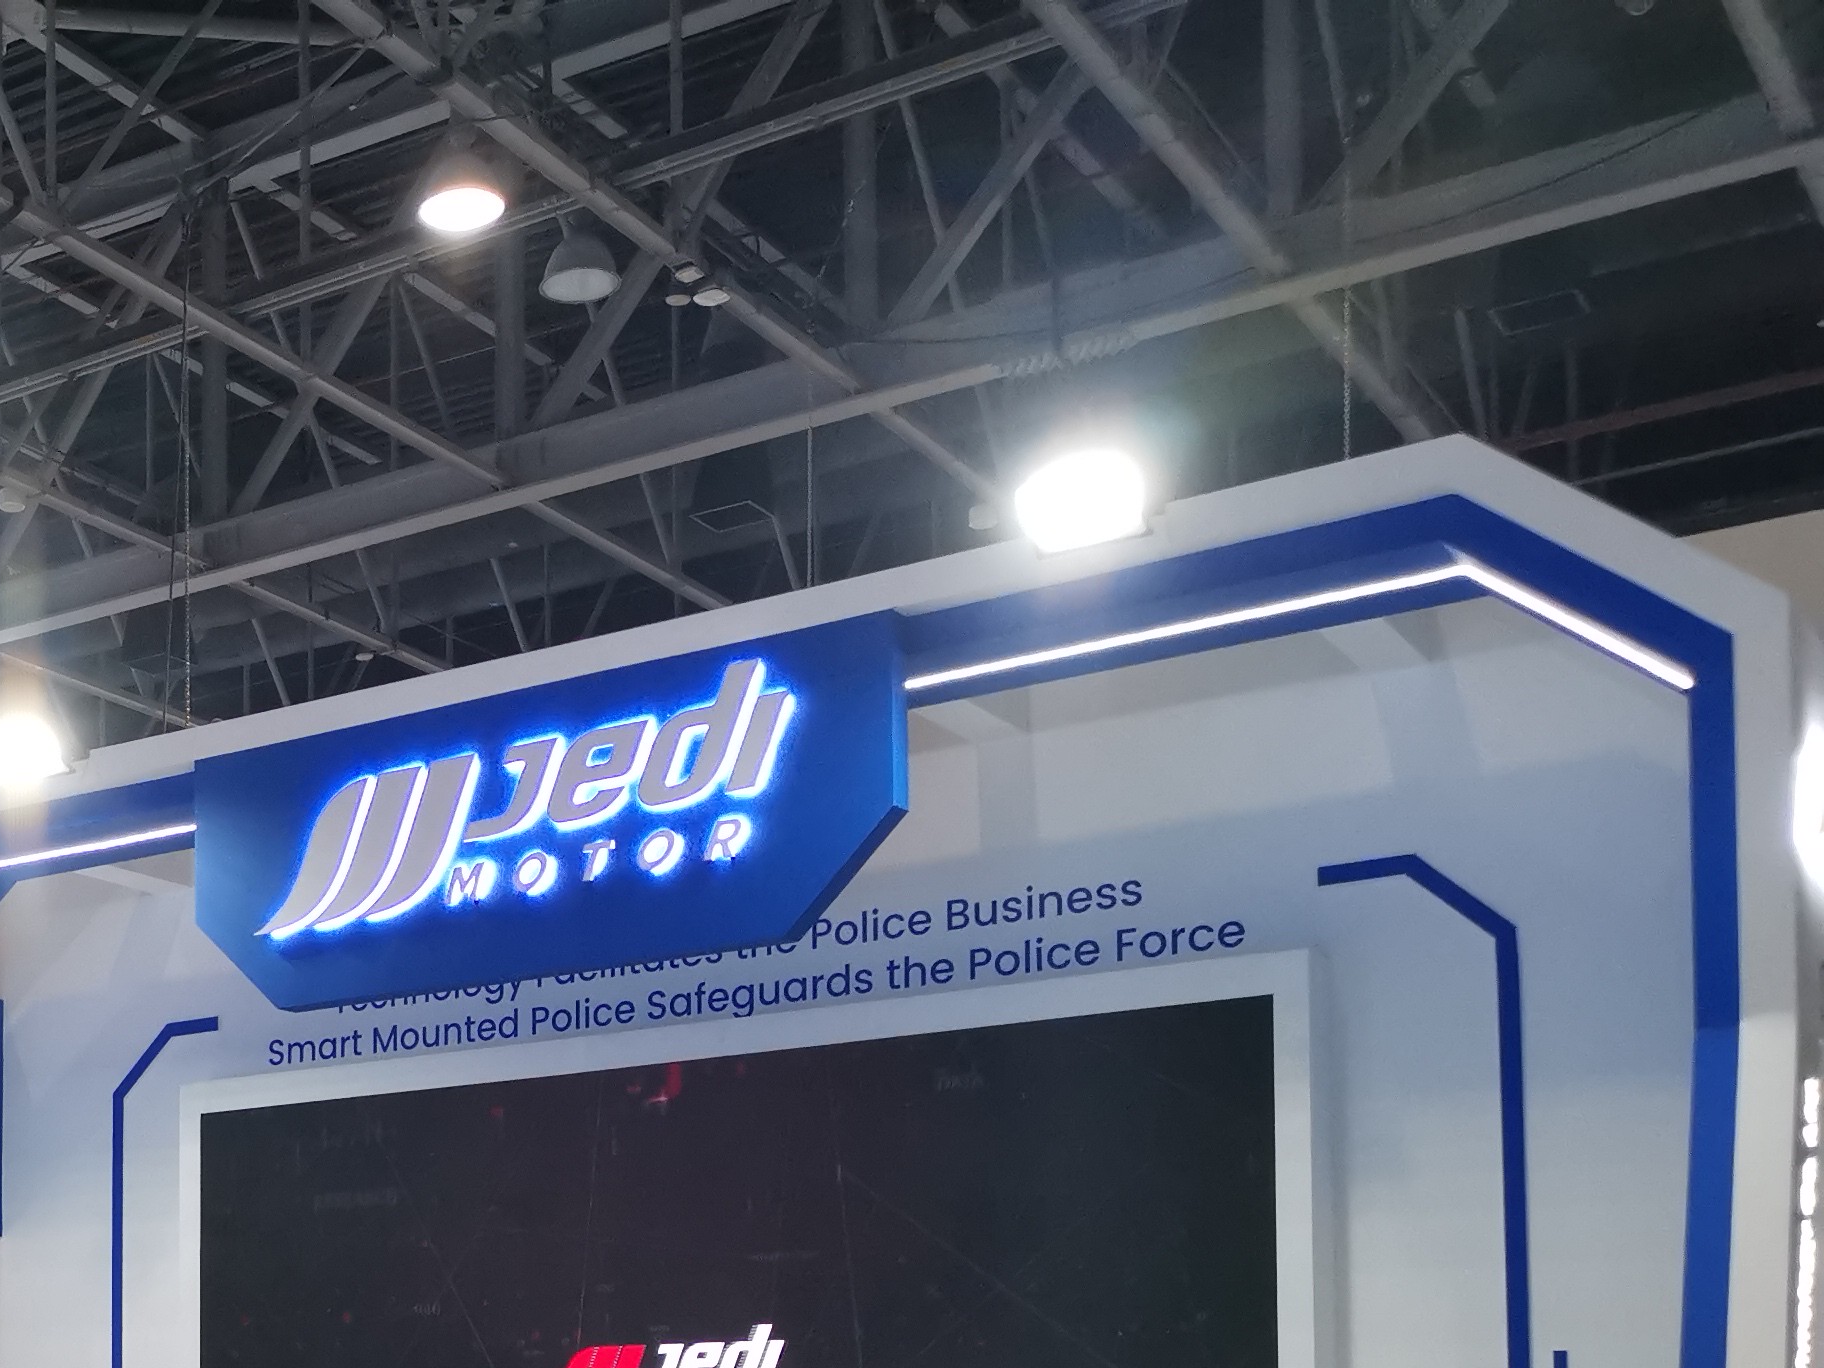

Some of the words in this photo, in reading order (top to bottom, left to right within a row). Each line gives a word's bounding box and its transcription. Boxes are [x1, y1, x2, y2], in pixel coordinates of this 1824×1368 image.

[447, 813, 753, 907] MOTOR
[811, 907, 932, 950] Police
[946, 879, 1143, 931] Business
[268, 1029, 363, 1066] Smart
[372, 1007, 519, 1055] Mounted
[531, 999, 636, 1036] Police
[647, 962, 873, 1020] Safeguards
[886, 955, 955, 990] the
[969, 936, 1101, 981] Police
[1116, 919, 1246, 962] Force
